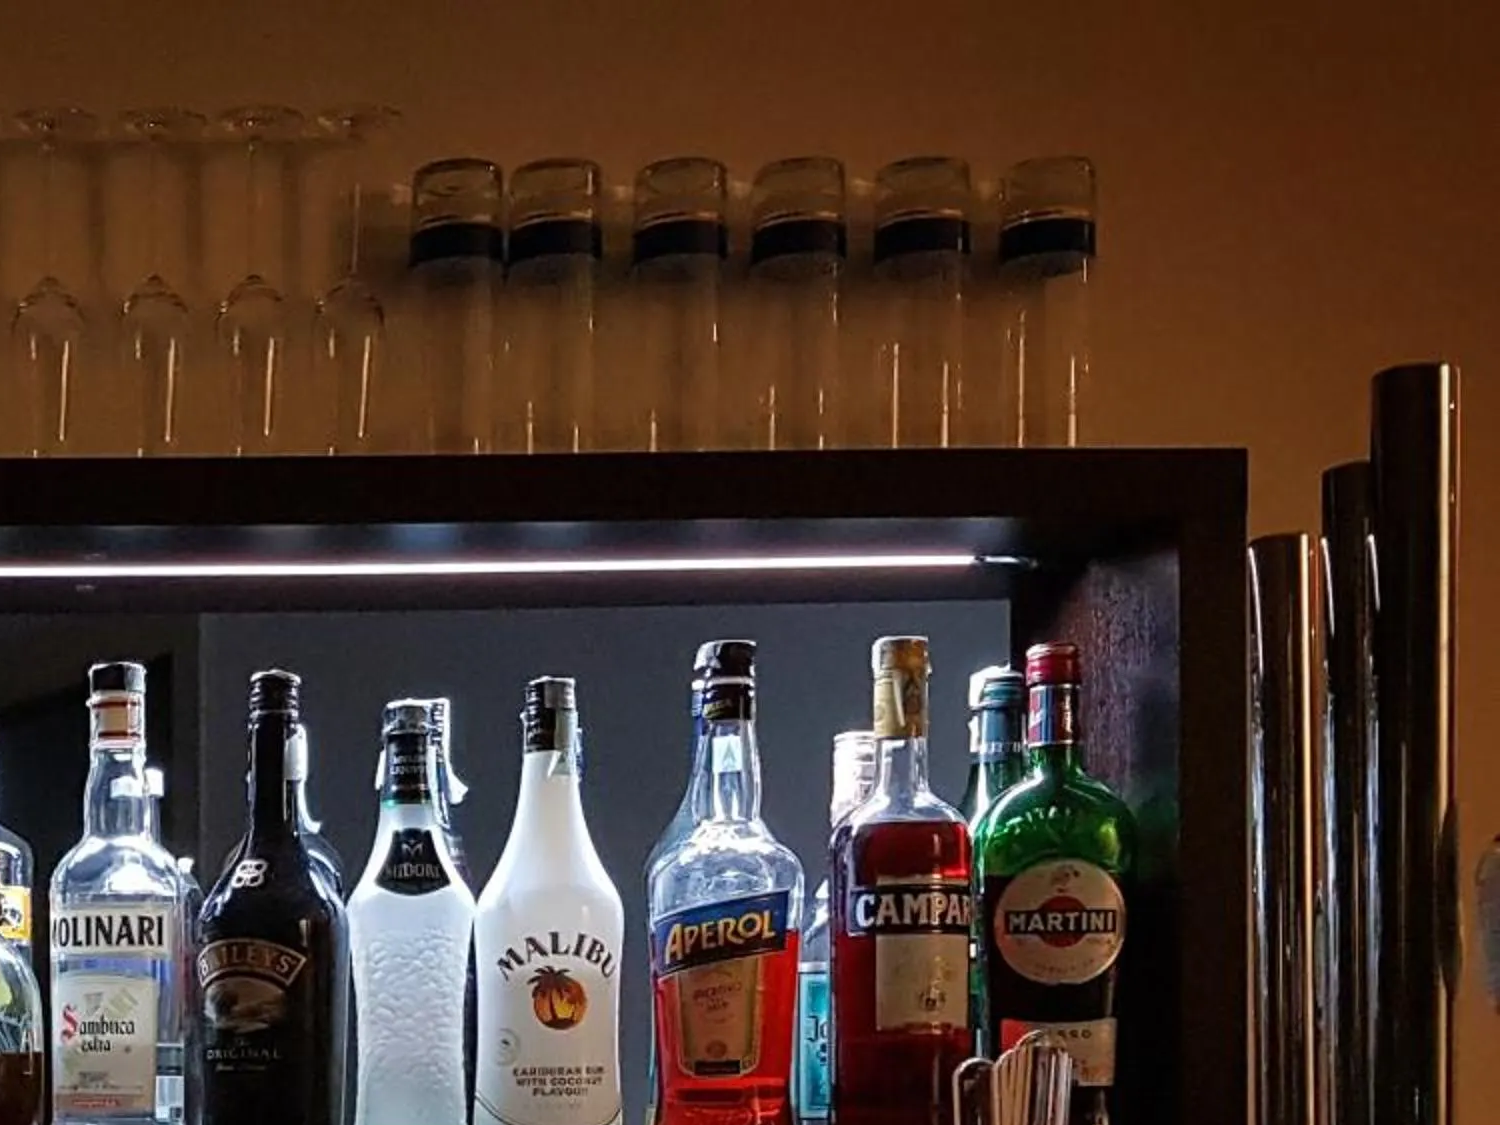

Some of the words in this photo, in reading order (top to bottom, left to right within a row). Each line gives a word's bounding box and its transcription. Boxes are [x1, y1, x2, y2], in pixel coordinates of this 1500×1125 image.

[52, 915, 165, 947] OLINARI
[664, 910, 777, 964] APEROL
[1008, 911, 1115, 933] MARTINI
[199, 944, 293, 977] BAILEYS
[497, 931, 617, 981] MALIBU
[60, 1003, 136, 1041] Sambuca
